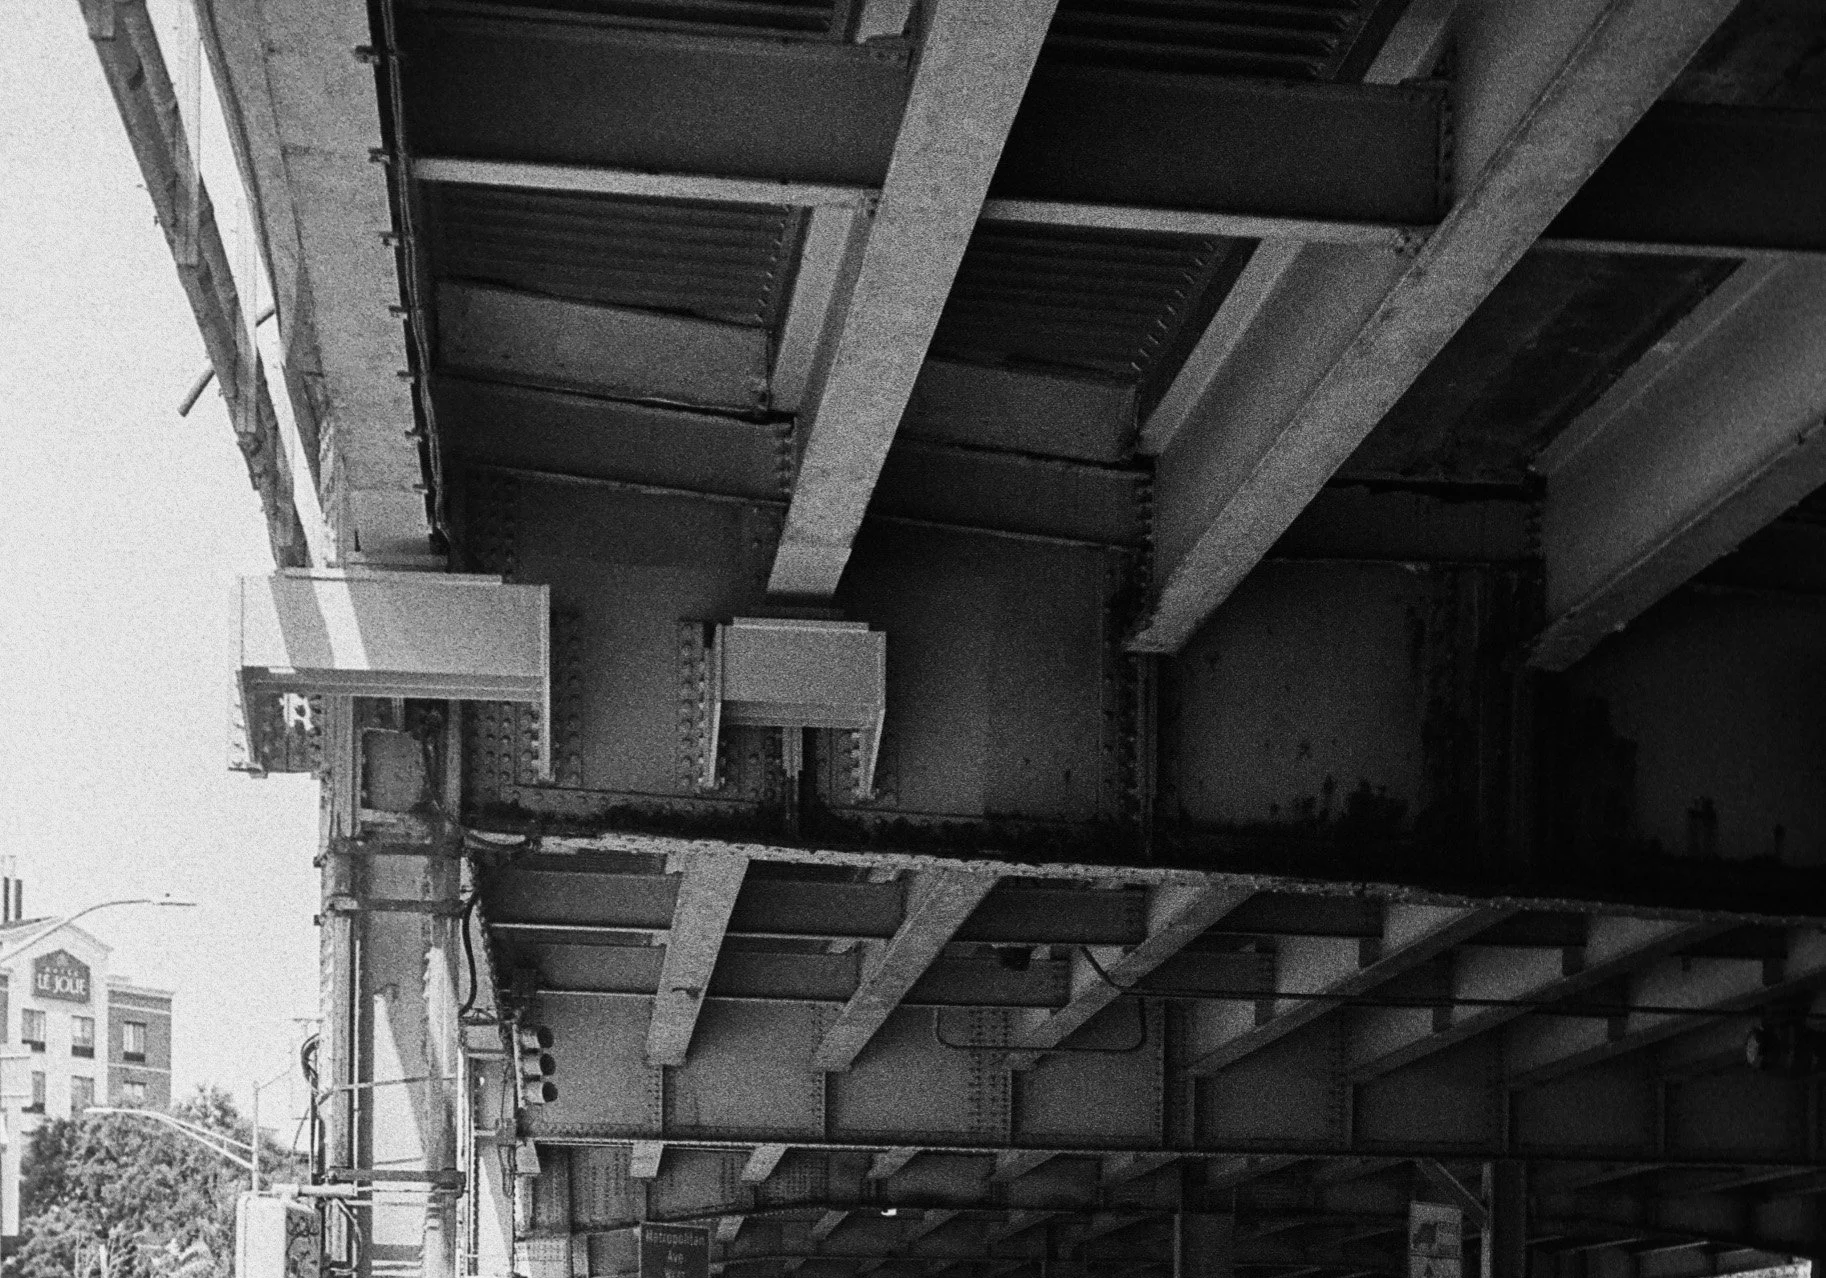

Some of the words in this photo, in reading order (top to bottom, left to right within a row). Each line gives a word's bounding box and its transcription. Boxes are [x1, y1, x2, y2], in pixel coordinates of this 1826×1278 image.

[37, 973, 50, 990] LE
[52, 975, 86, 995] JOLIE
[667, 1249, 685, 1265] Ave
